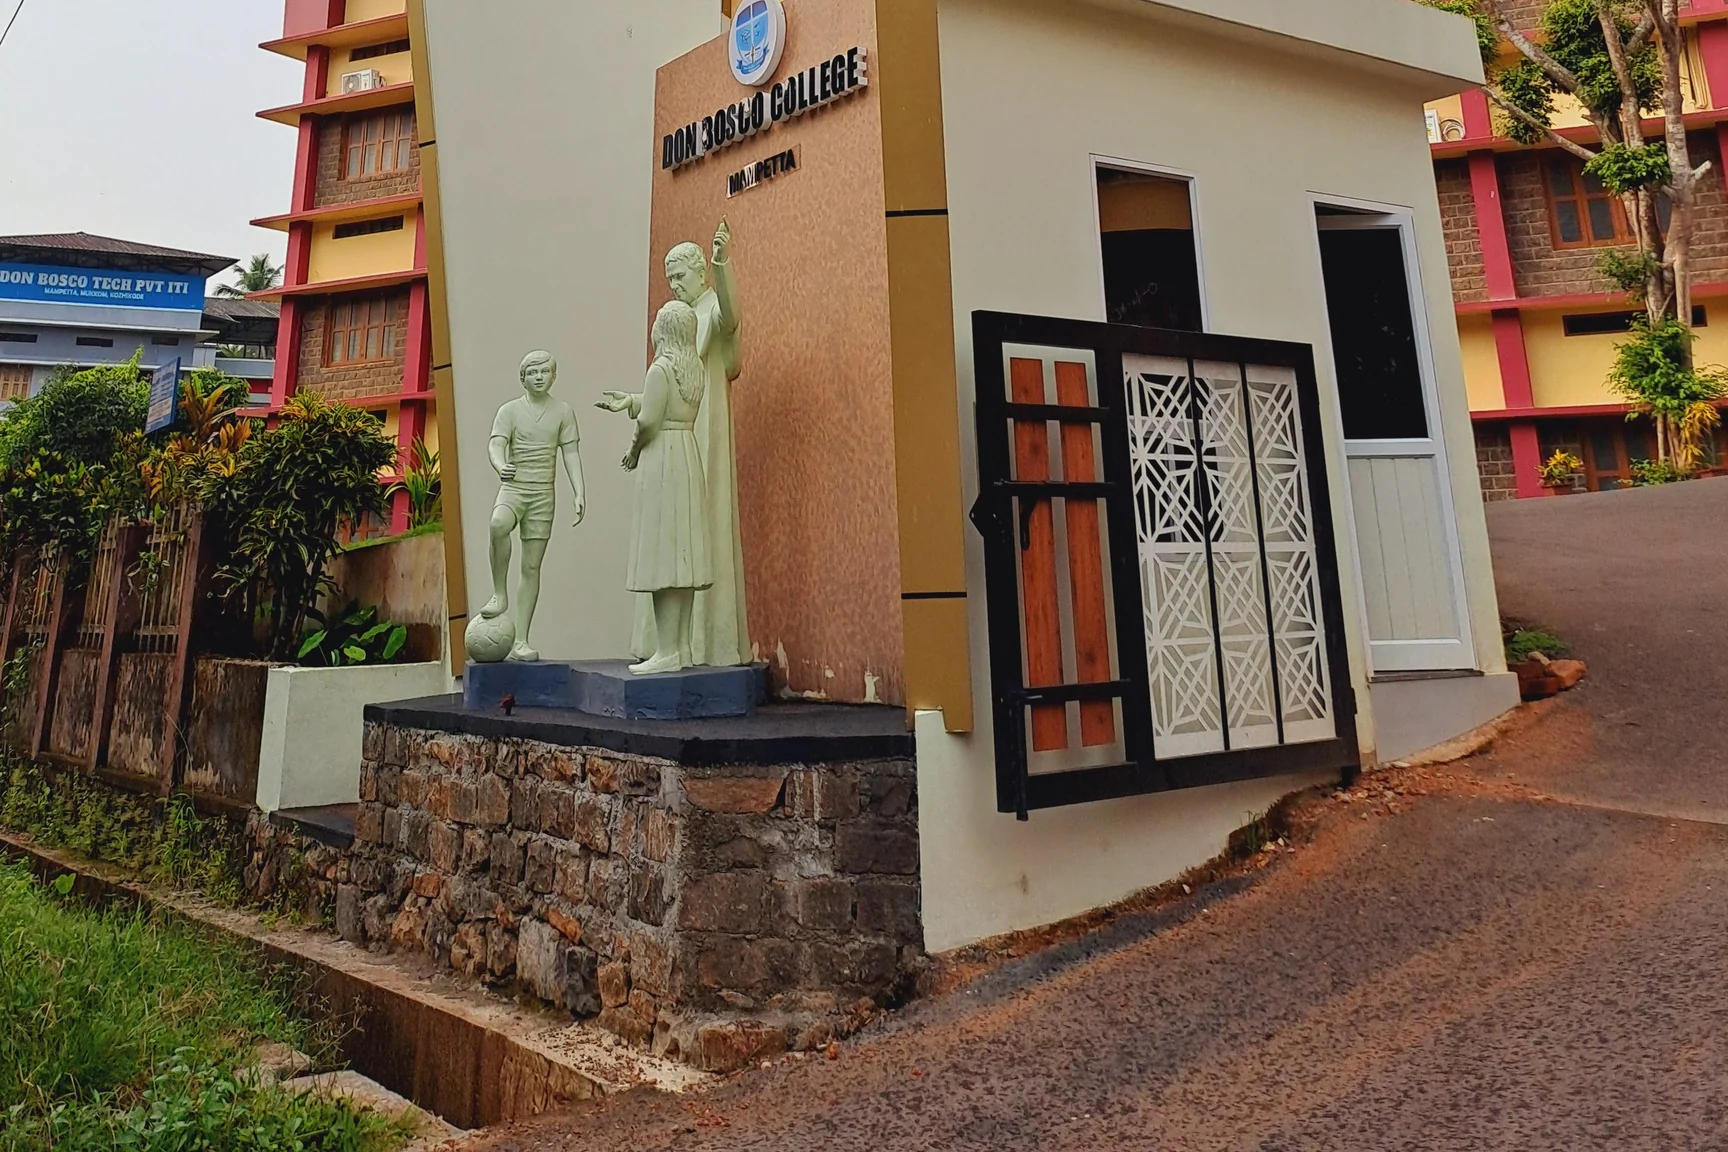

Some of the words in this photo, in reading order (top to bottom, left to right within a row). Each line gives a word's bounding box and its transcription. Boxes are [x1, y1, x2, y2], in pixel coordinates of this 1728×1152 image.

[661, 121, 699, 170] DON
[701, 91, 764, 152] BOSCO
[770, 46, 861, 123] COLLEGE
[728, 148, 796, 196] MAMPETTA
[0, 270, 34, 285] DON
[37, 272, 88, 288] BOSCO
[92, 276, 132, 291] TECH
[135, 279, 164, 293] PVT
[167, 281, 189, 294] ITI
